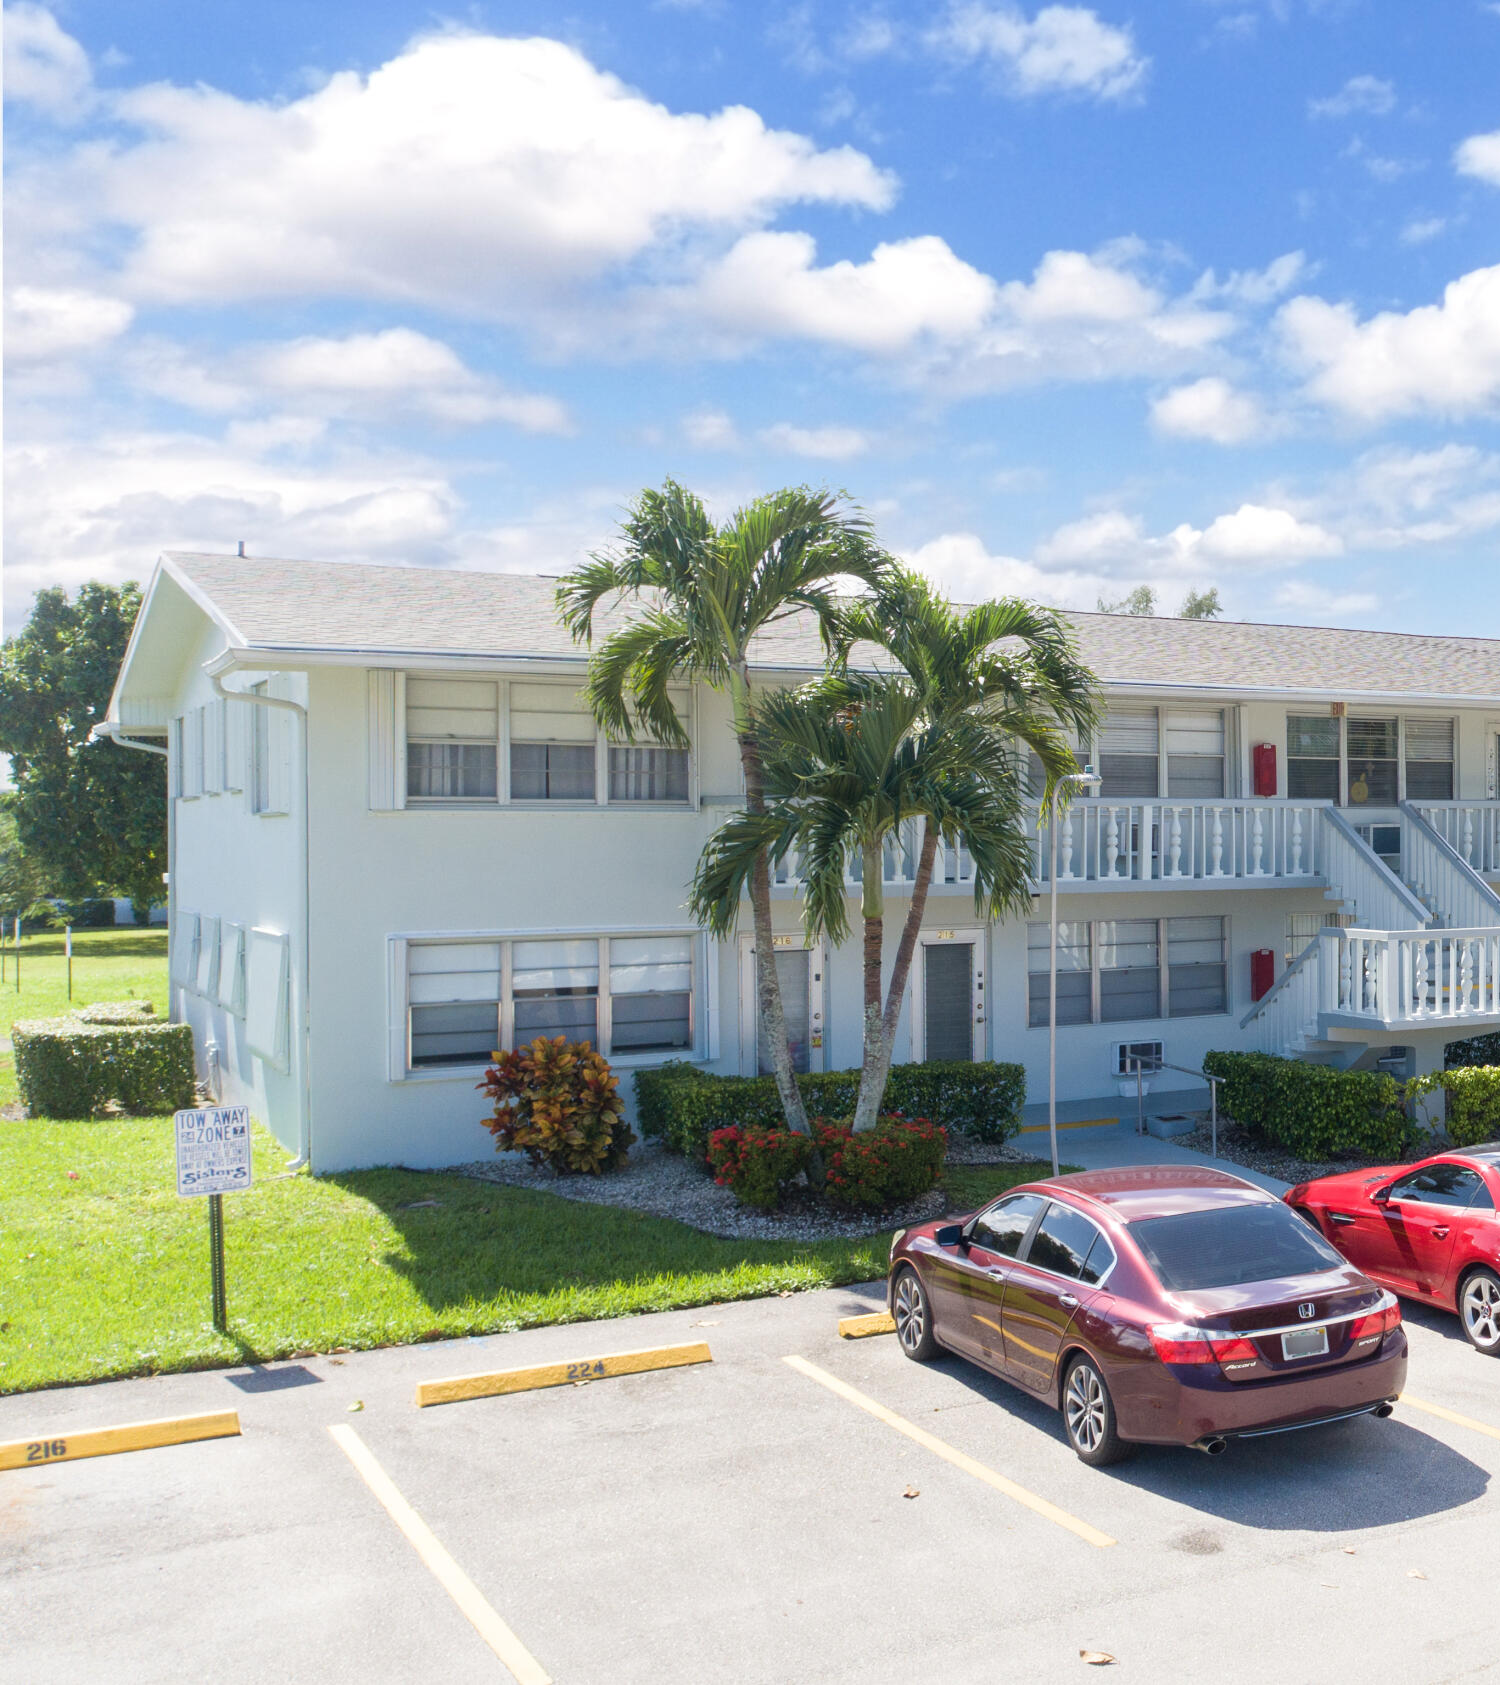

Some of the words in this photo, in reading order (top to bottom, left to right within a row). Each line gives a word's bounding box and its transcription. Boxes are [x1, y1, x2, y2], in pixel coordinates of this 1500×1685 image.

[180, 1113, 206, 1129] TOW
[213, 1108, 245, 1126] AWAY
[197, 1125, 231, 1143] ZONE
[567, 1360, 605, 1379] 224
[1225, 1361, 1257, 1371] Accord
[26, 1439, 67, 1461] 216
